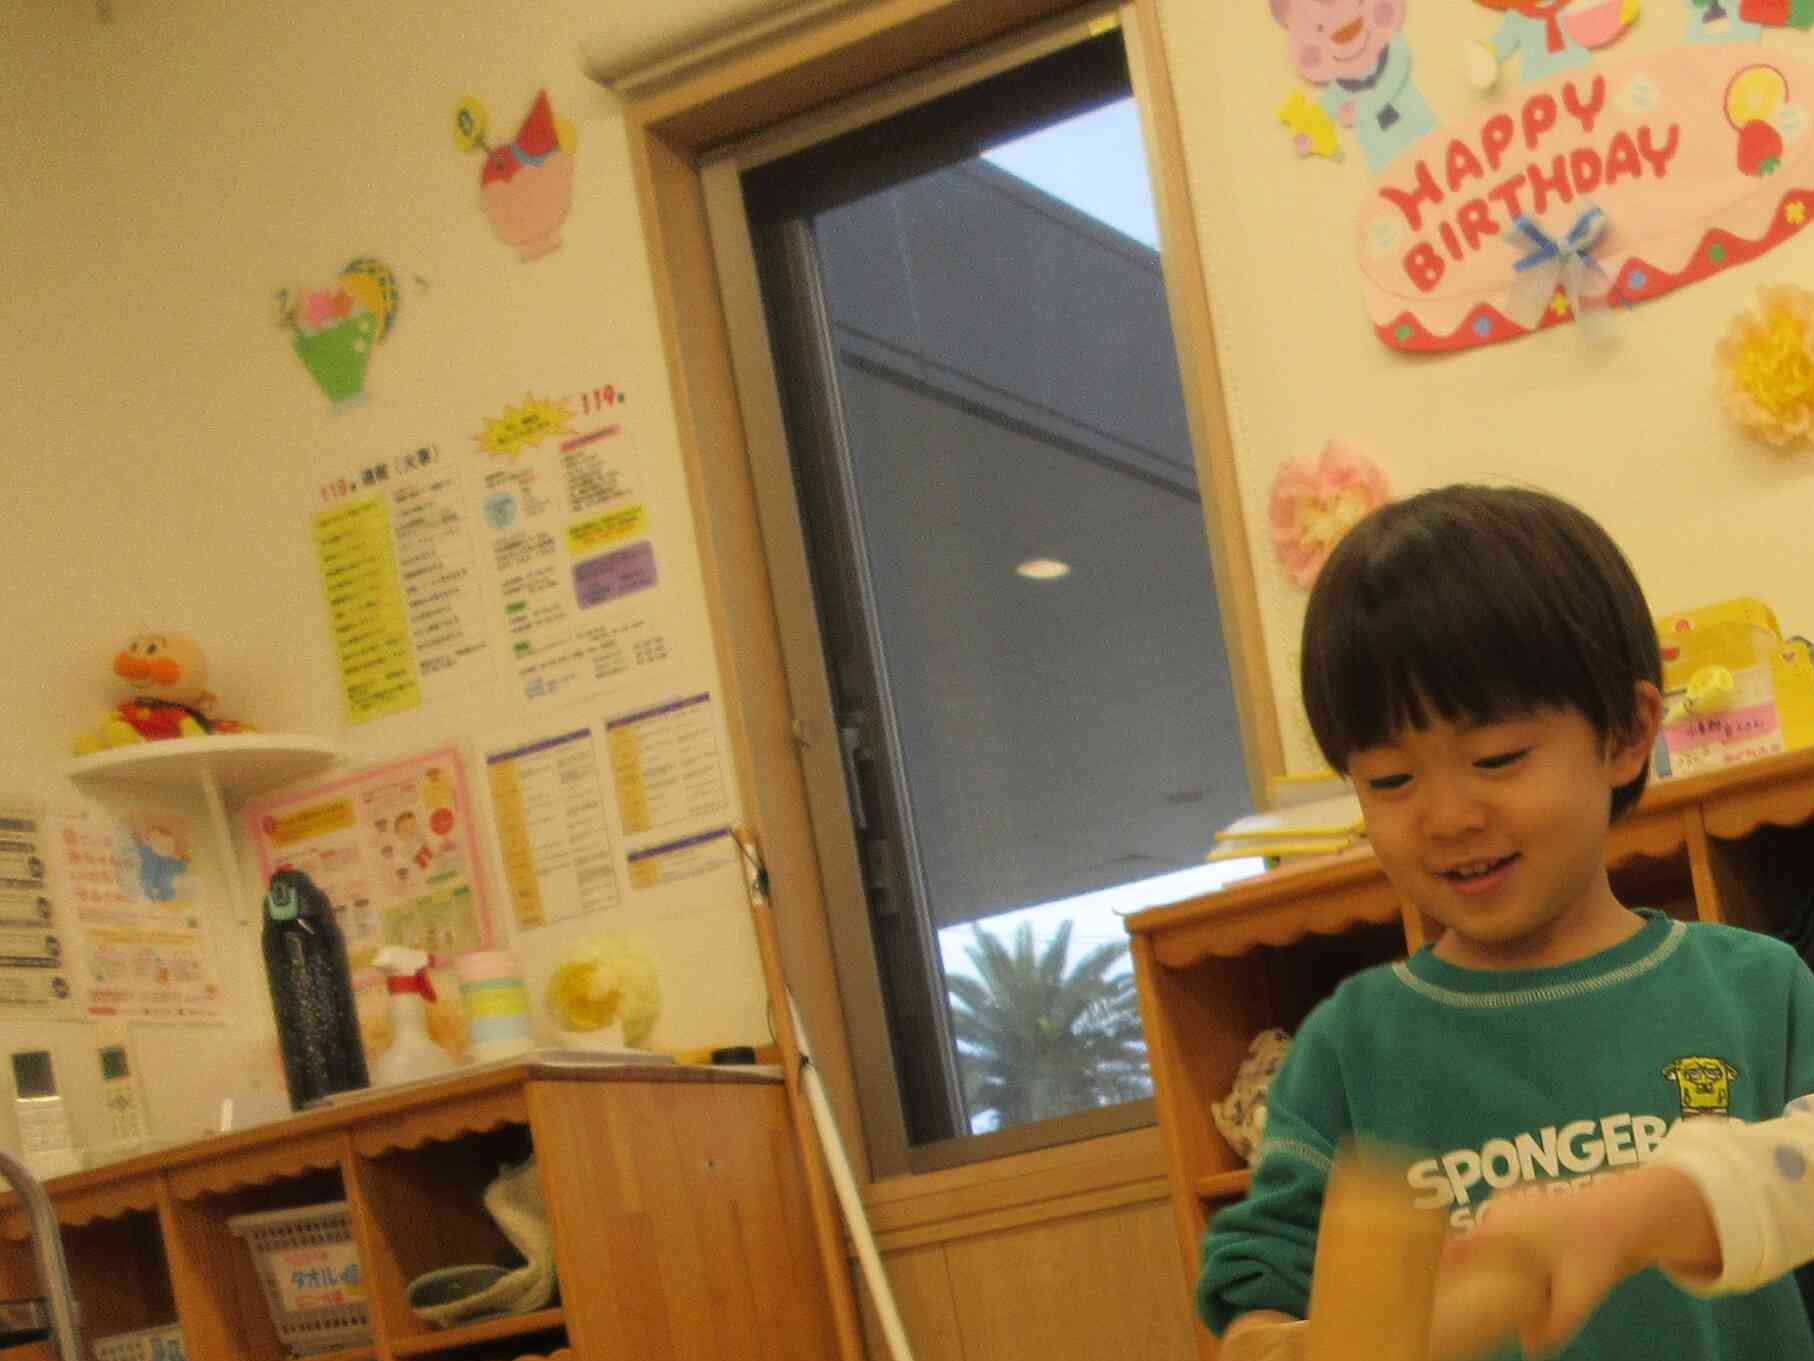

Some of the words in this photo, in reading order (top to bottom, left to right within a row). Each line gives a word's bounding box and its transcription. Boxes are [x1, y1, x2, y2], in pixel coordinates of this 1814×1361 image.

[1378, 75, 1605, 231] HAPPY
[1403, 123, 1679, 292] BIRTHDAY
[1407, 1113, 1667, 1210] SPONGEB
